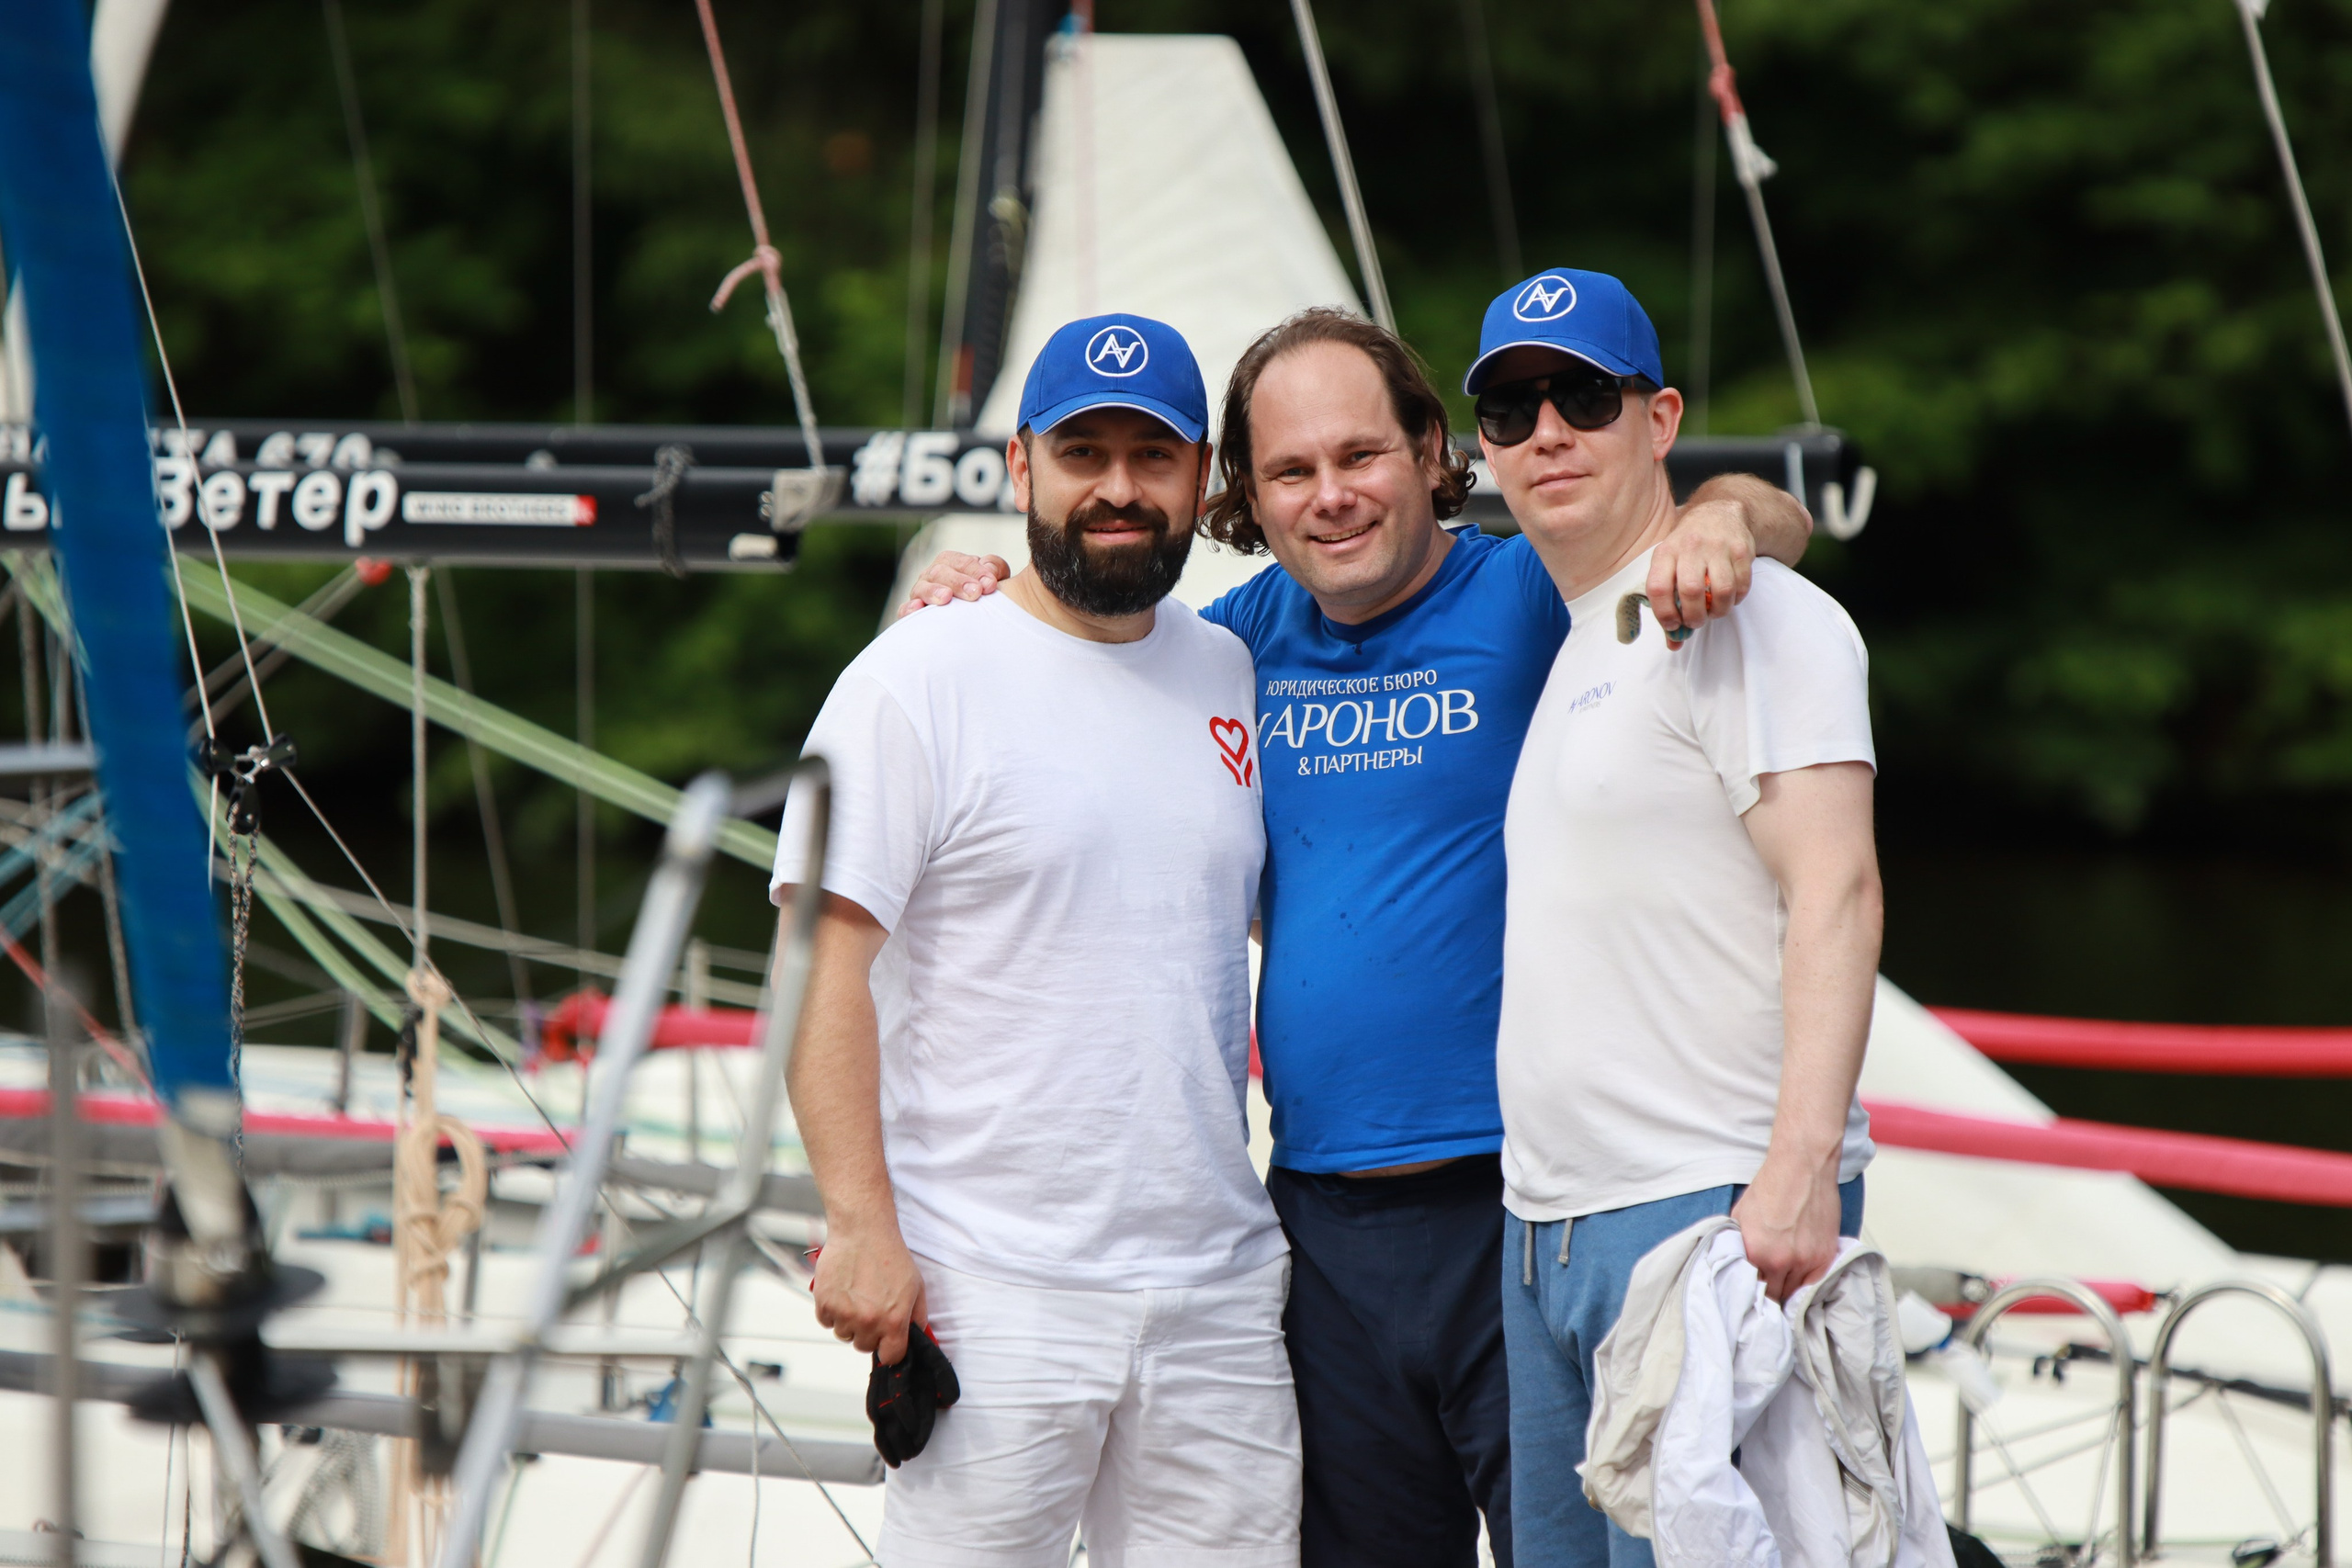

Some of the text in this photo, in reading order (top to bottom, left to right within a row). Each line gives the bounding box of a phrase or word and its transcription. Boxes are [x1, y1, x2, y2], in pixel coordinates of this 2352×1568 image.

[851, 431, 1014, 512] #Бо
[1266, 670, 1437, 699] ЮРИДИЧЕСКОЕ БЮРО
[1297, 746, 1423, 776] & ПАРТНЕРЫ
